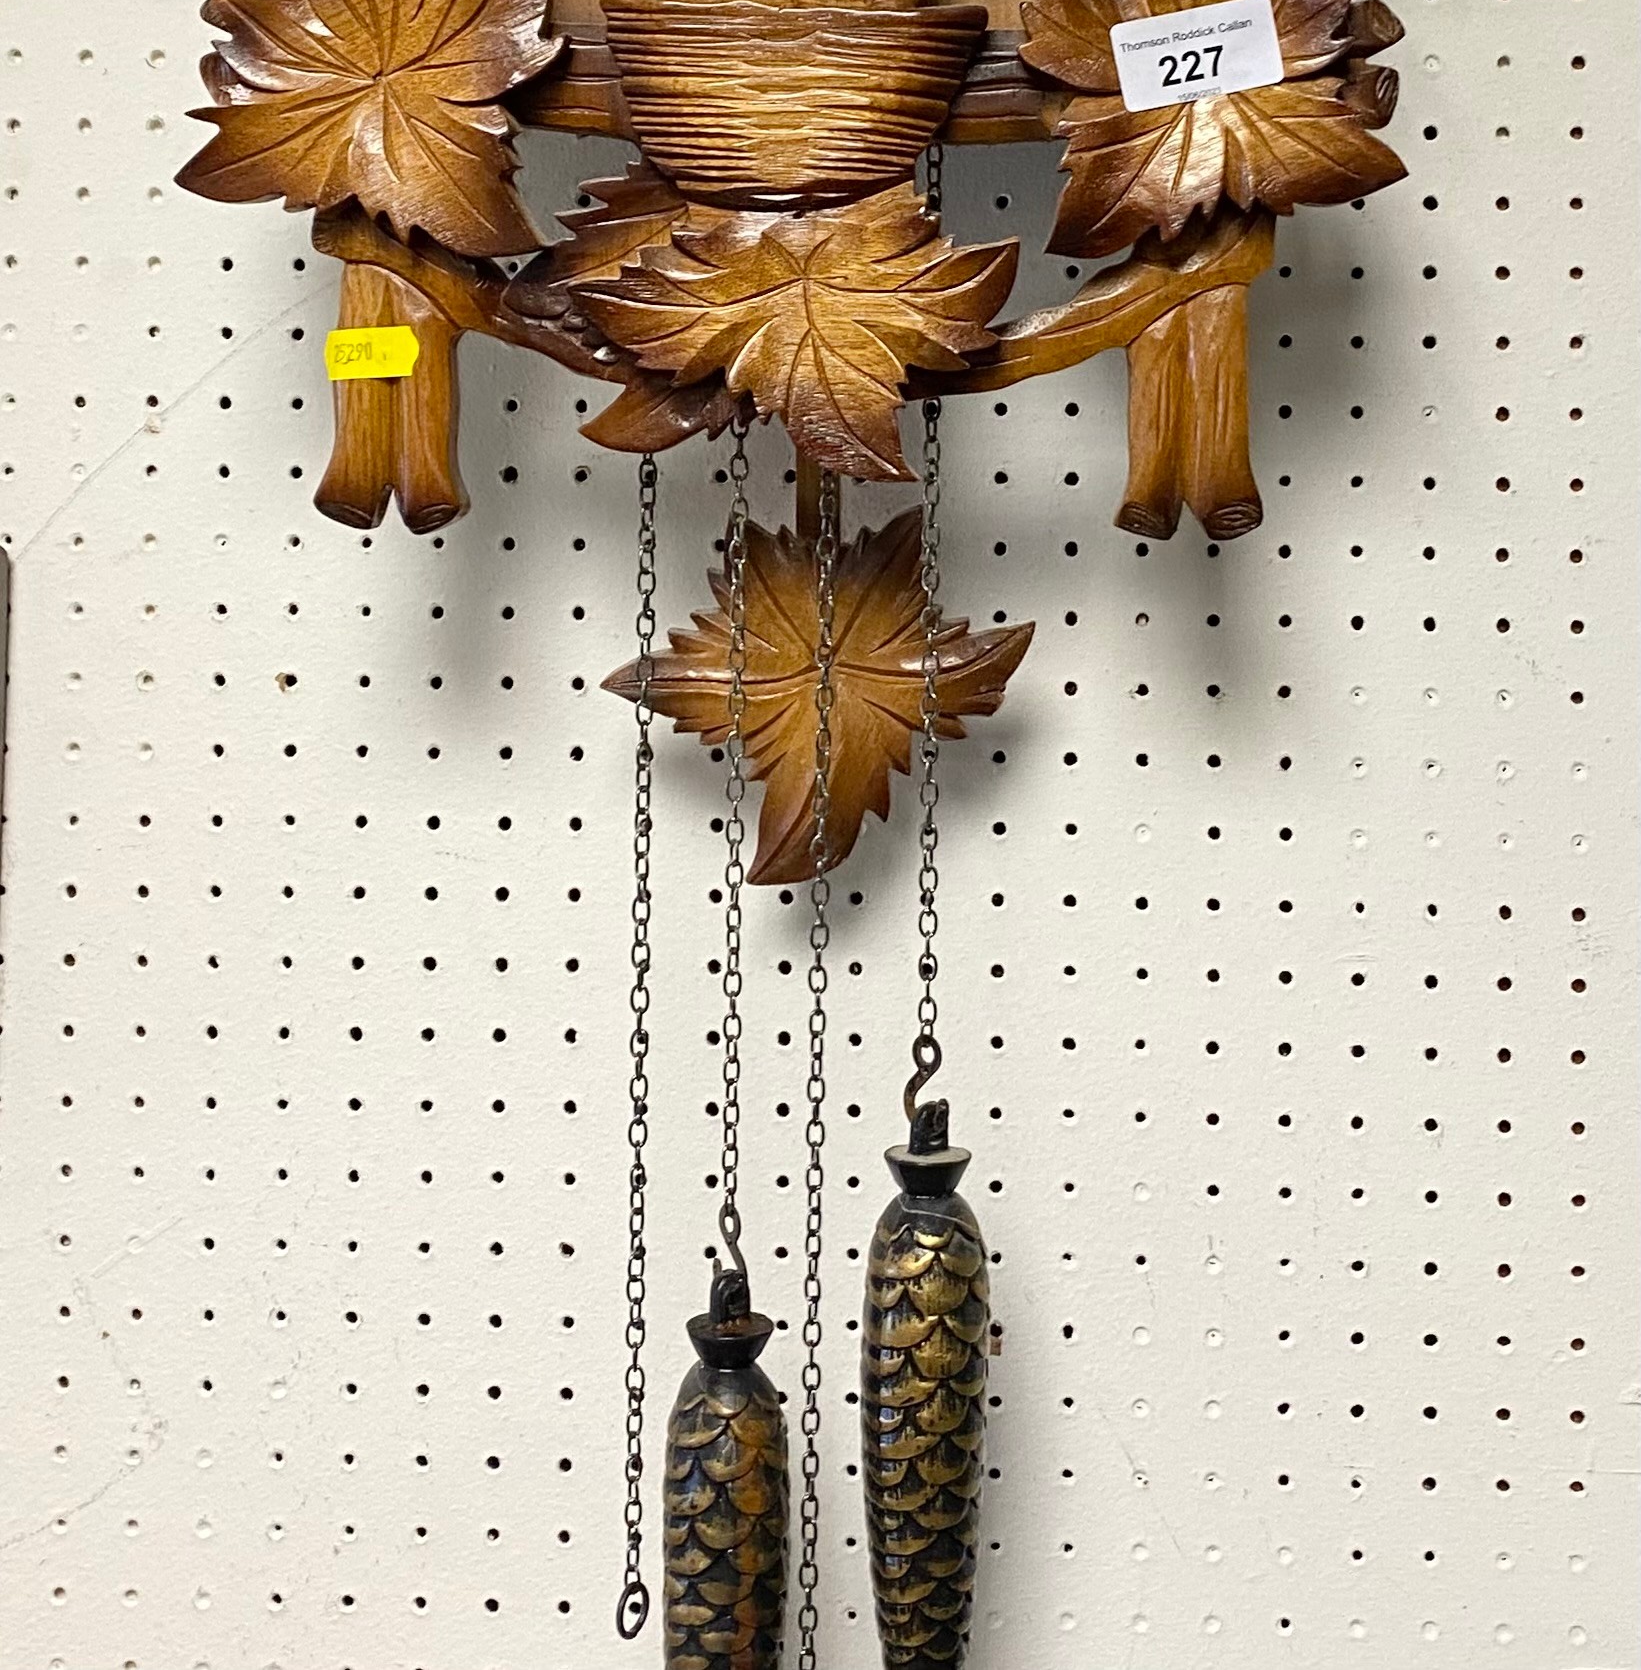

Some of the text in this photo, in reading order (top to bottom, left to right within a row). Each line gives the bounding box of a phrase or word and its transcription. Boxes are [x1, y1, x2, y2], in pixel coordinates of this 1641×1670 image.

[1119, 18, 1253, 53] Thomson Roddick Callan
[1158, 45, 1223, 88] 227
